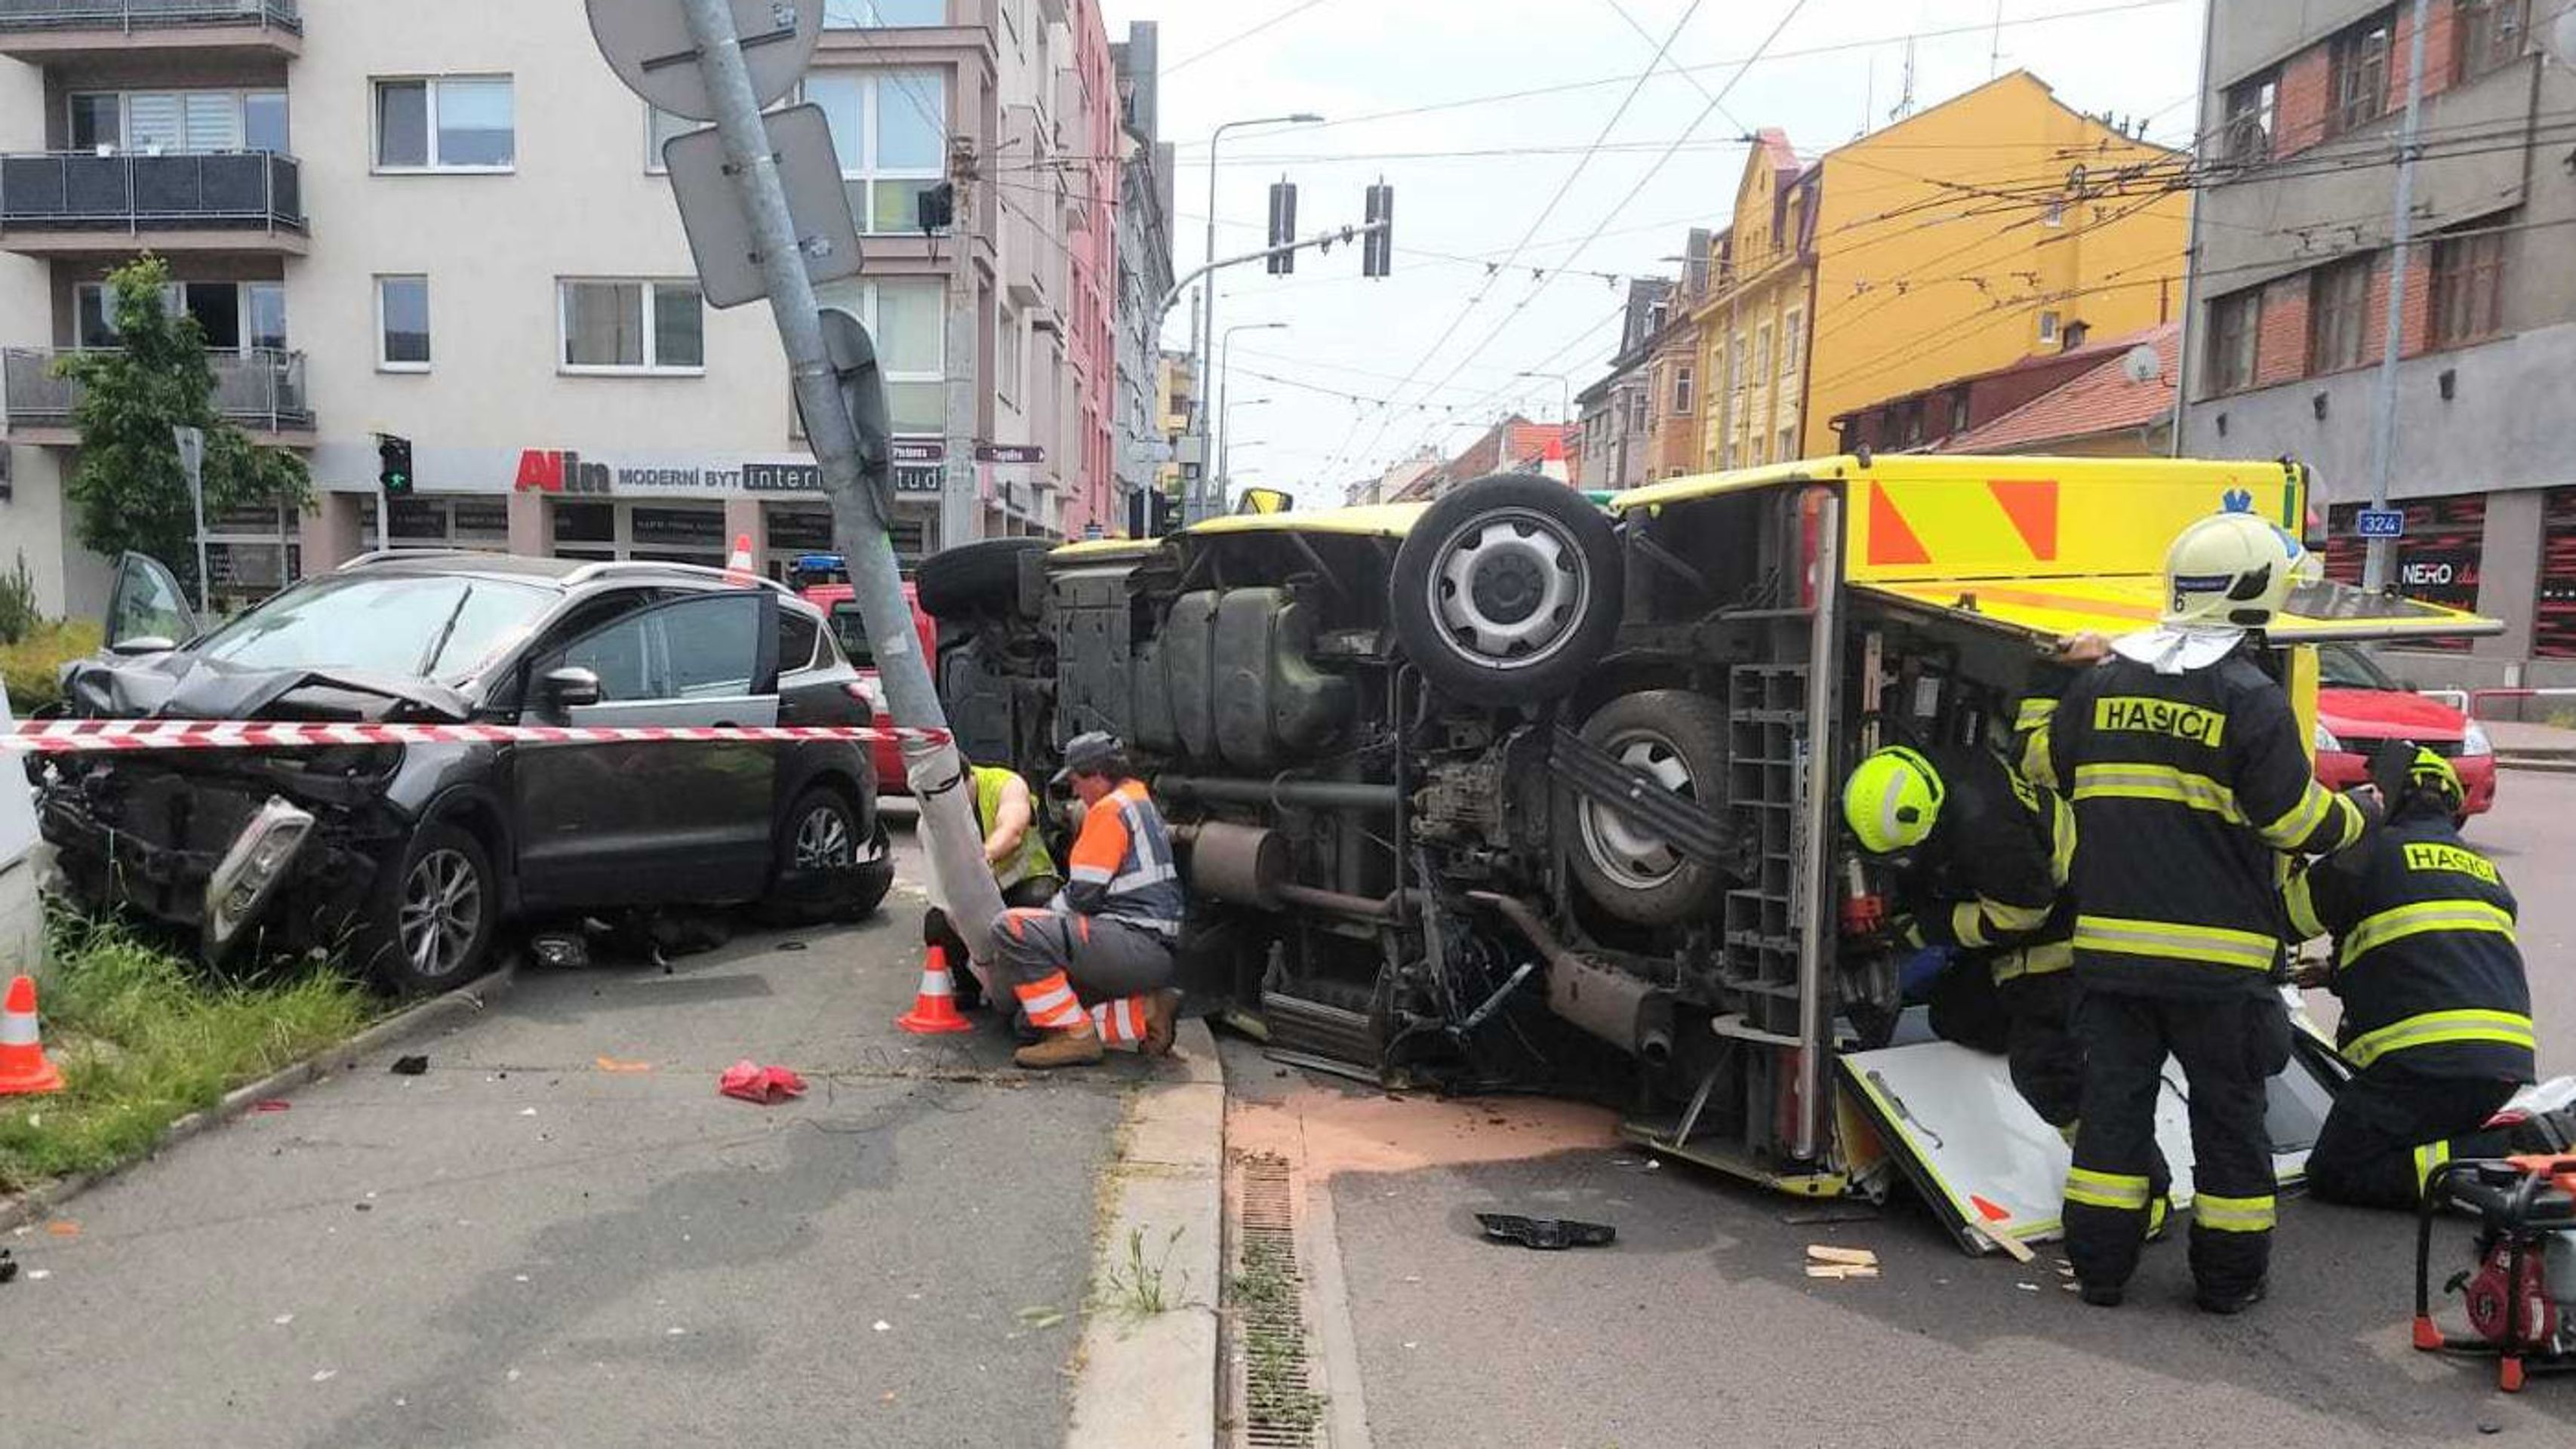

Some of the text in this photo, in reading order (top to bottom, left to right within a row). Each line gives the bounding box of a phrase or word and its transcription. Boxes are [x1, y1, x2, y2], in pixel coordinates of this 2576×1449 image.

[618, 466, 740, 488] MODERNÍ BYT
[749, 466, 937, 488] interi tud
[2365, 515, 2395, 531] 324
[2402, 563, 2452, 585] NERO
